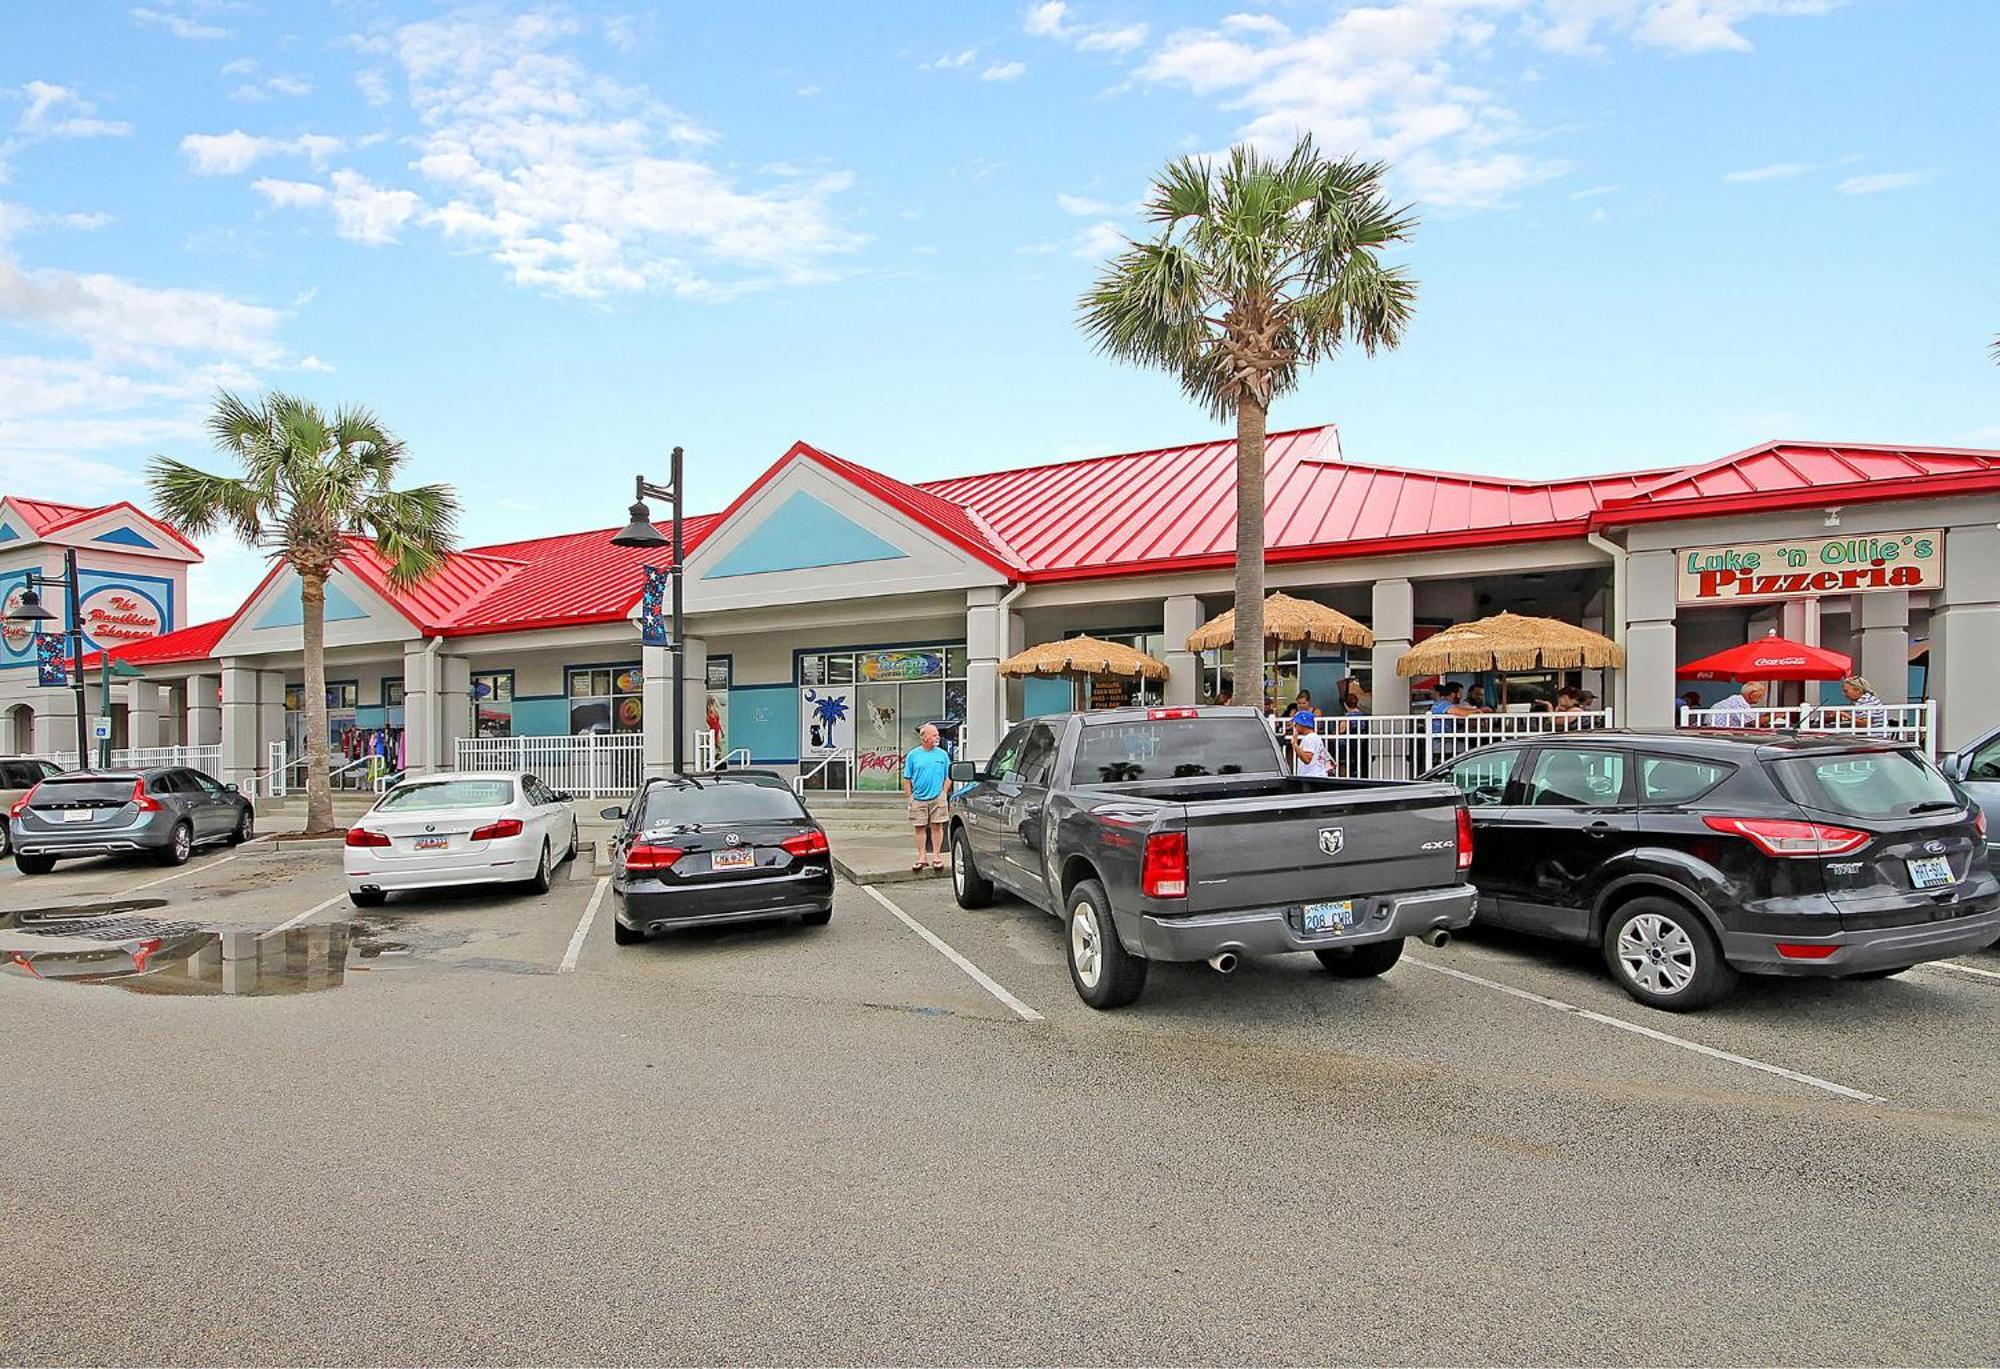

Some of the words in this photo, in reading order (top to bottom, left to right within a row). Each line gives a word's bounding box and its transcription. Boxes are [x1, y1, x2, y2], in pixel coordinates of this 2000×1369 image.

[1687, 550, 1761, 575] Luke
[1820, 535, 1934, 566] Ollie's
[1695, 558, 1924, 598] Pizzeria
[108, 596, 138, 611] The
